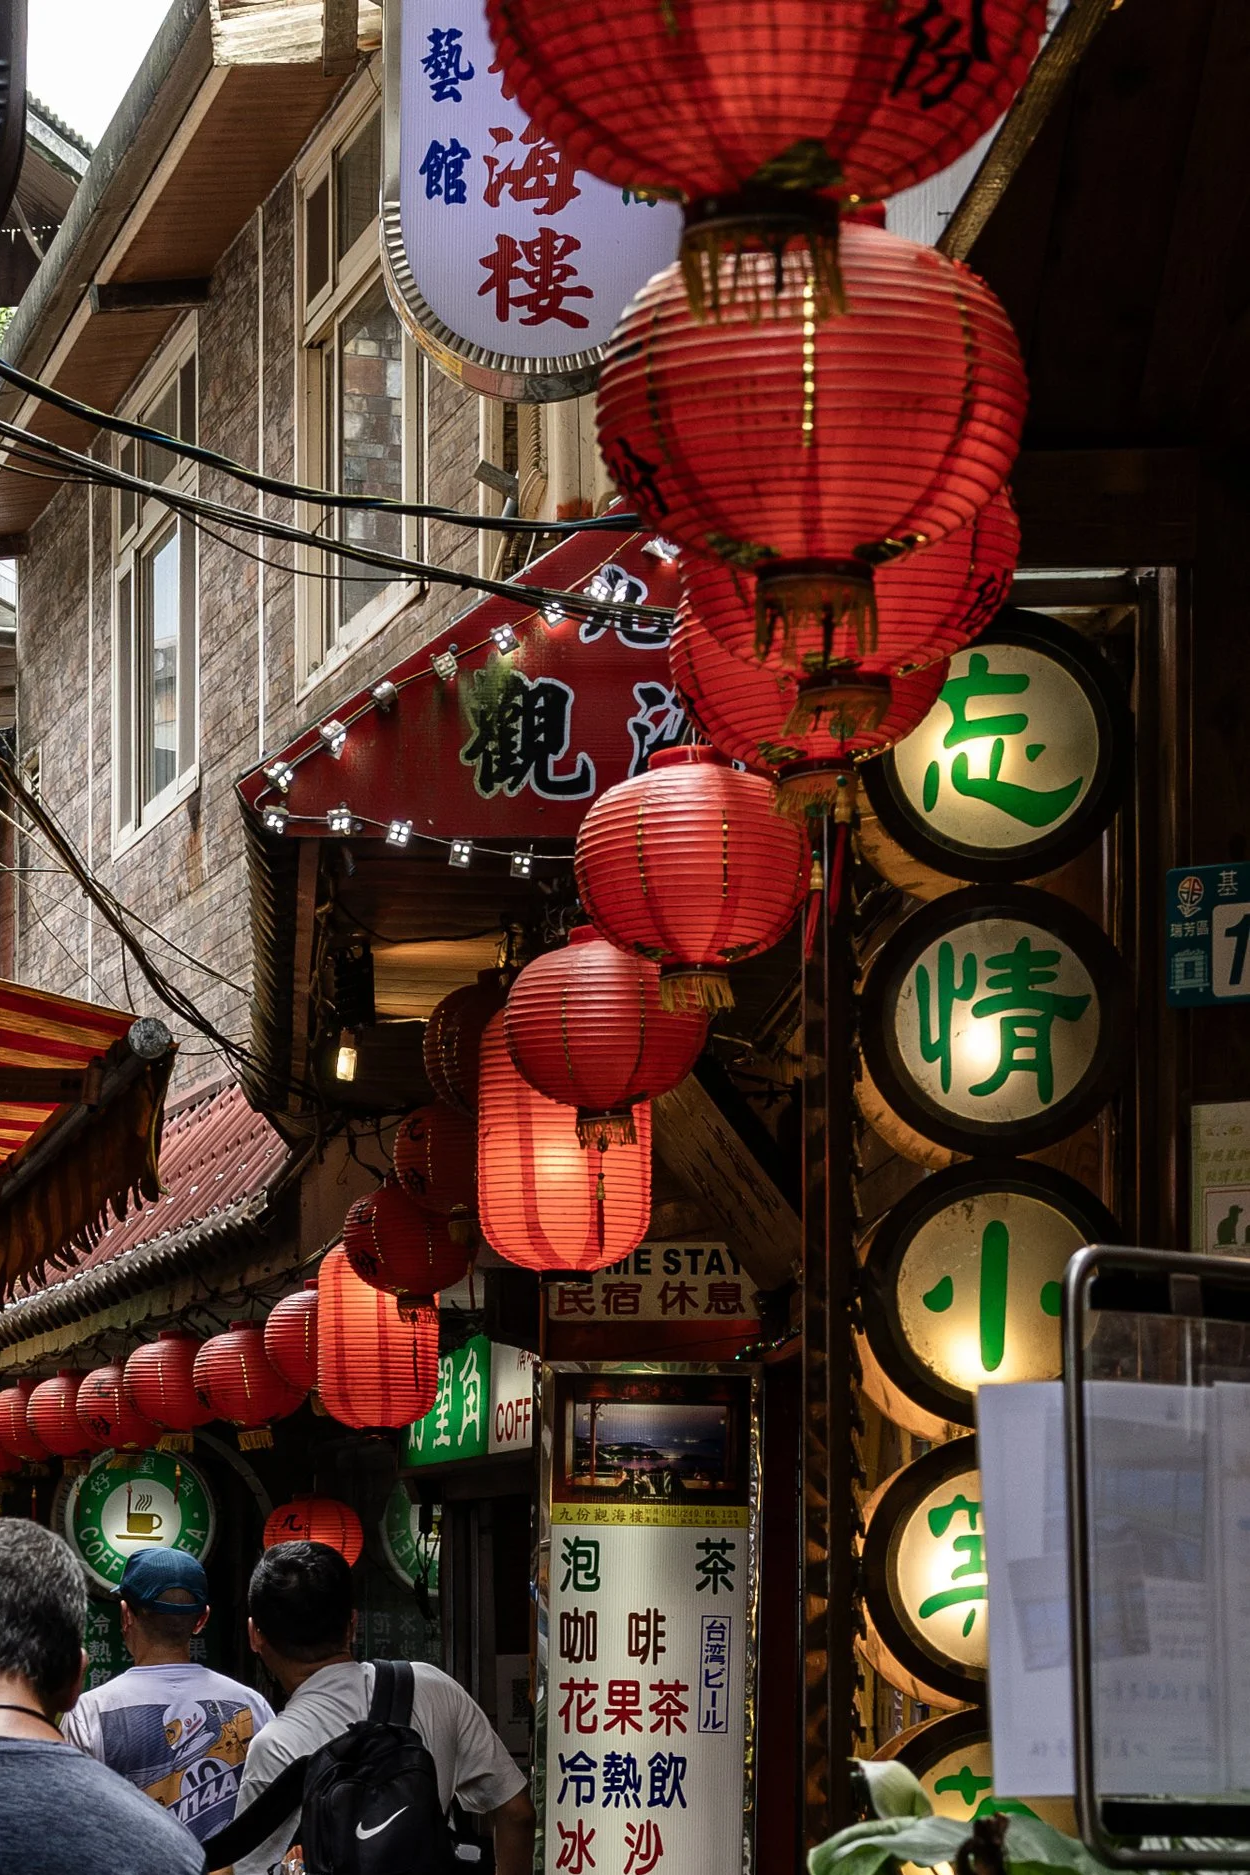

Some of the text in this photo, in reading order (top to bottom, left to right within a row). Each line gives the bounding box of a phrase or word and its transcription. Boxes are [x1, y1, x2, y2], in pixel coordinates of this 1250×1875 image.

[478, 55, 594, 328] 海樓
[605, 1248, 651, 1275] ME
[555, 1281, 746, 1316] 民宿 休息
[496, 1397, 532, 1443] COFF
[79, 1526, 125, 1576] COFF
[178, 1527, 207, 1557] EA
[560, 1607, 667, 1666] 咖啡
[559, 1677, 690, 1736] 花果茶
[557, 1750, 688, 1809] 冷熱飲
[556, 1819, 665, 1875] 冰沙
